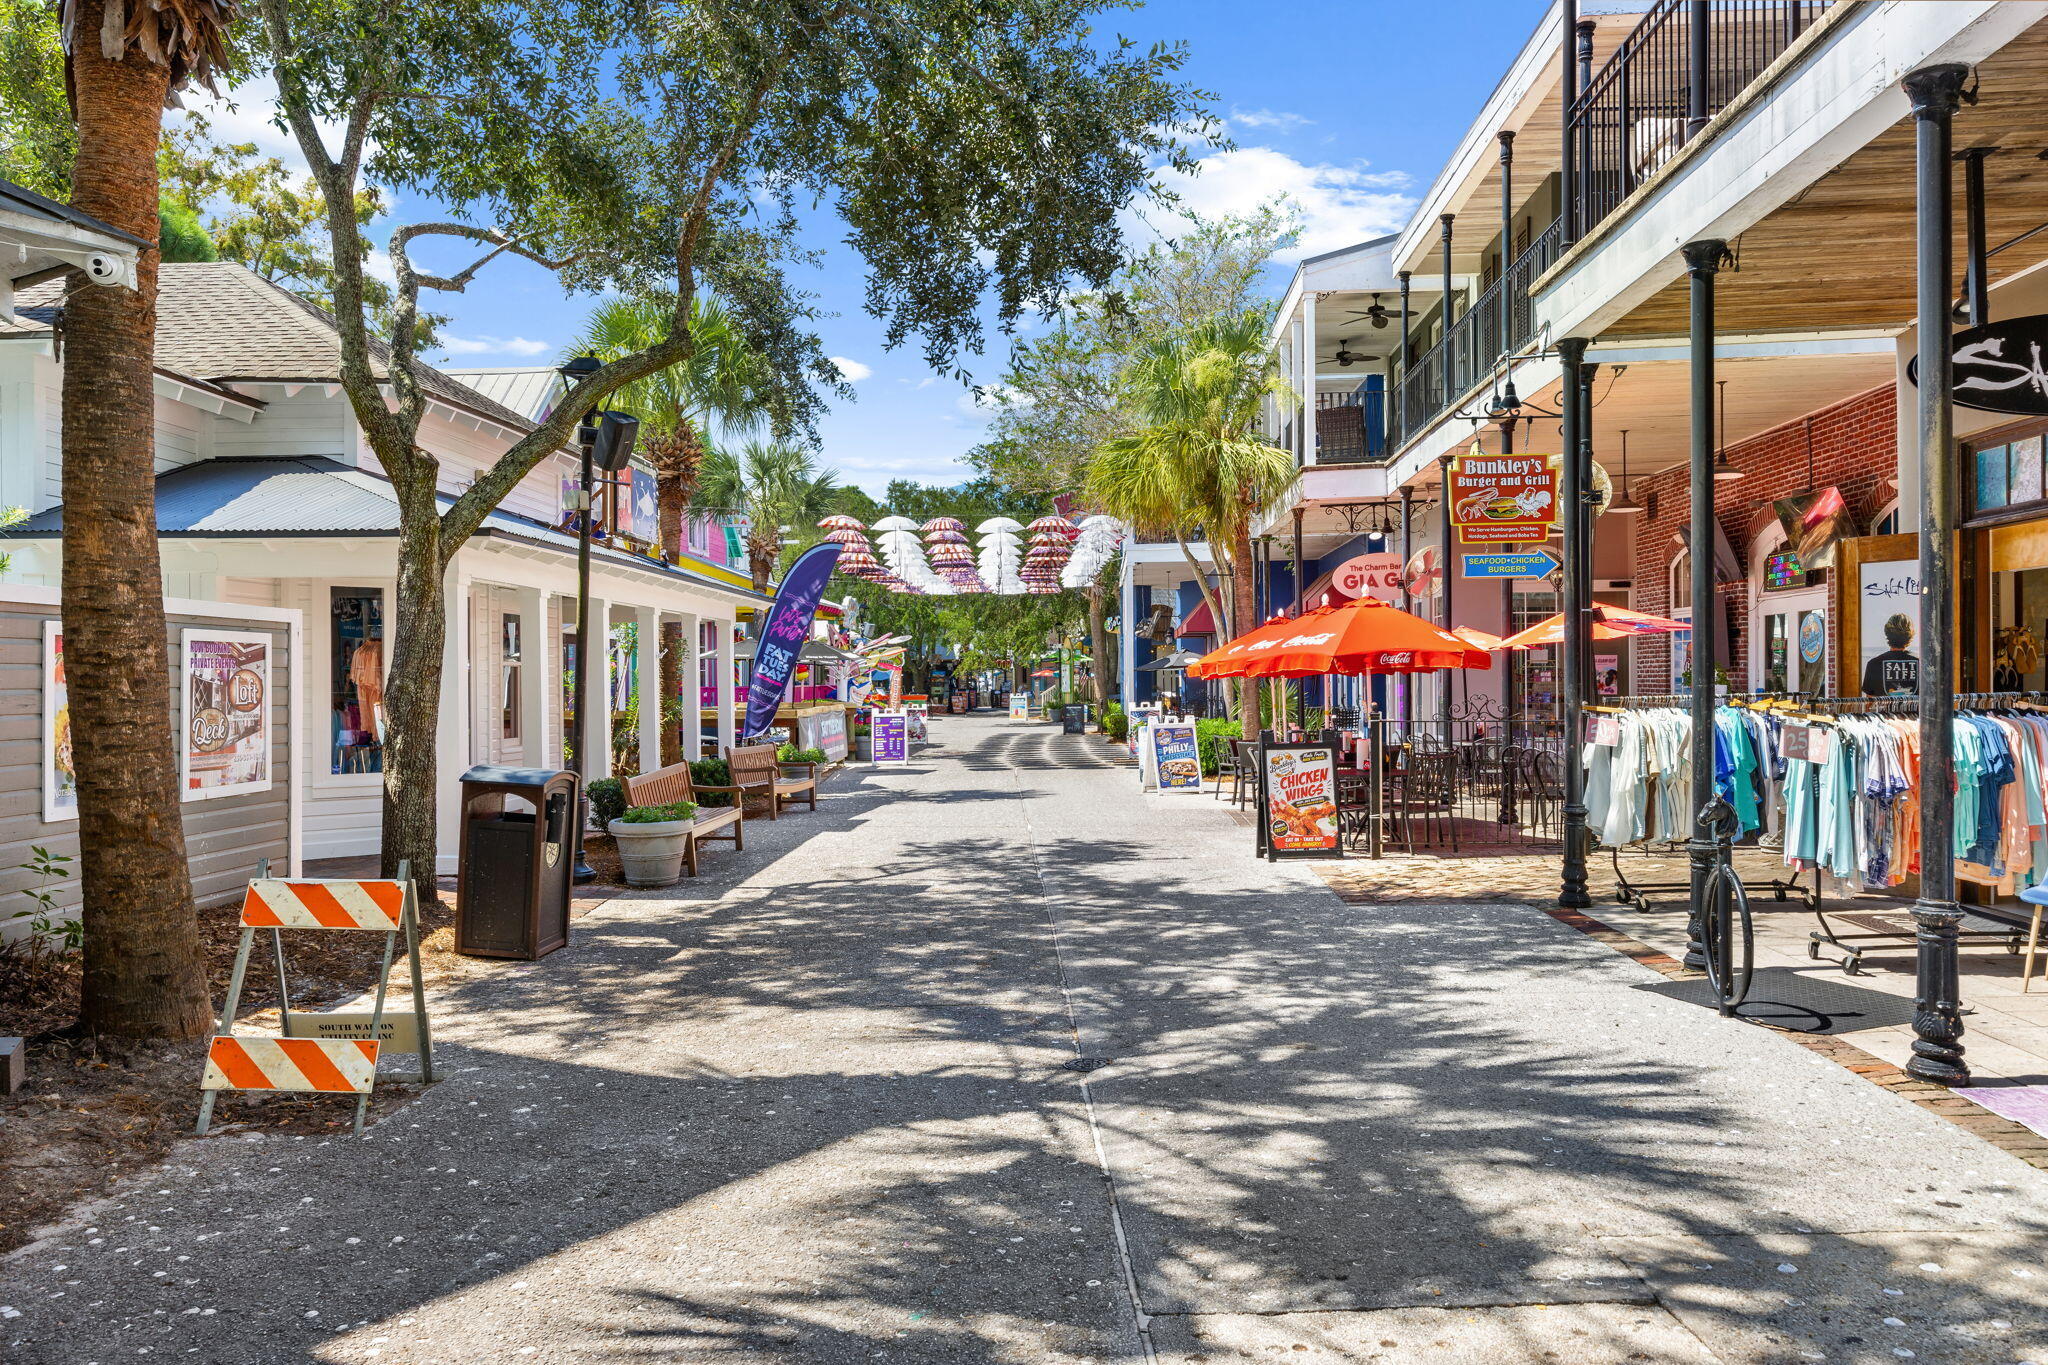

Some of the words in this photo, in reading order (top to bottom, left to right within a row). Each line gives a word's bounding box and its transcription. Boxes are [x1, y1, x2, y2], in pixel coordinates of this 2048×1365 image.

[1465, 458, 1542, 475] Bunkley's
[1457, 477, 1497, 488] Burger
[1500, 475, 1521, 486] and
[1524, 474, 1550, 485] Grill
[1364, 564, 1388, 572] Charm
[1343, 573, 1379, 590] GIA
[764, 642, 794, 660] FAT
[190, 658, 214, 668] PRIVATE
[215, 658, 237, 669] EVENTS
[762, 654, 789, 674] TUES
[1886, 662, 1916, 671] SALT
[1886, 670, 1916, 680] LIFE
[234, 676, 258, 705] Loft
[192, 716, 225, 745] Deck
[1162, 742, 1189, 755] PHILLY
[1280, 768, 1328, 790] CHICKEN
[1284, 783, 1324, 802] WINGS
